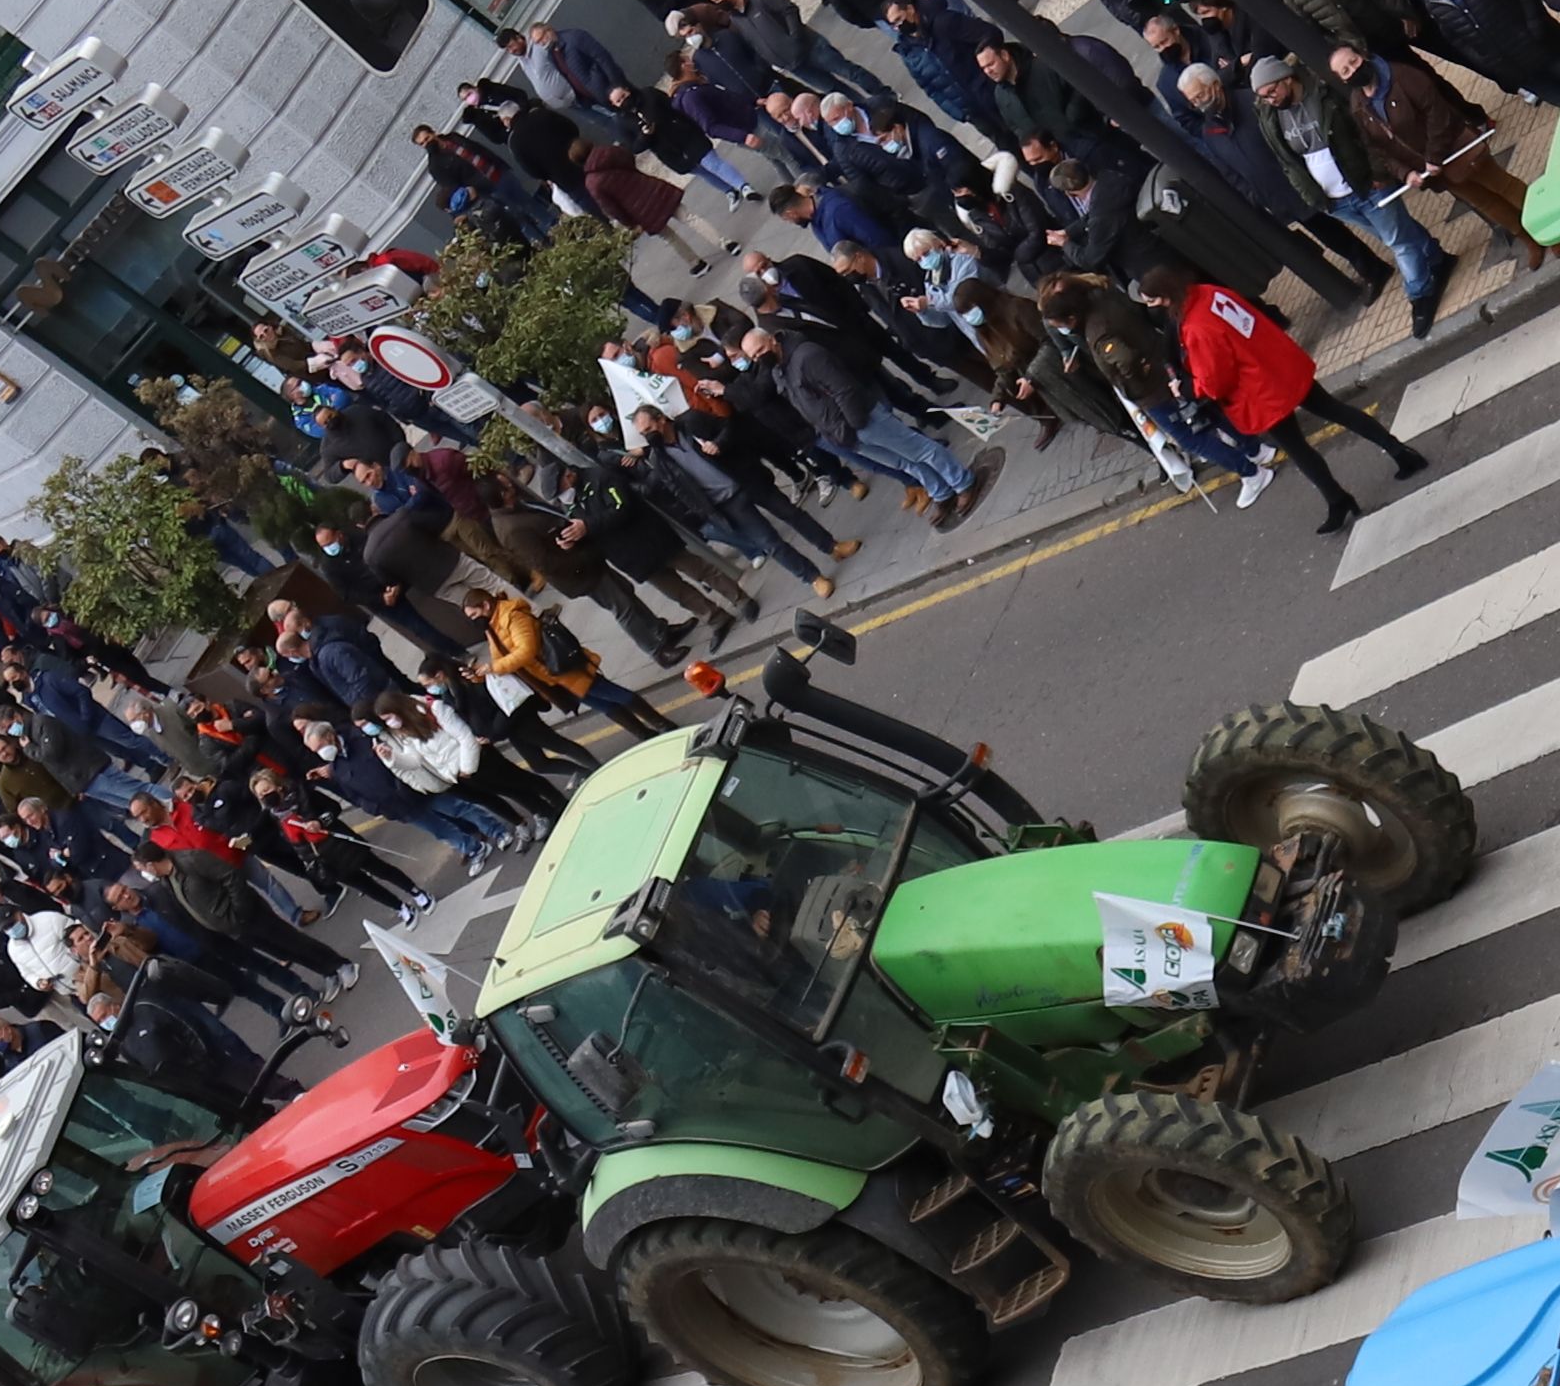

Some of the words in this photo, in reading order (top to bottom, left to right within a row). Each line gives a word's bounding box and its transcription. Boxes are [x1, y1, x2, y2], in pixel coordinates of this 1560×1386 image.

[50, 65, 103, 103] SALAMANCA
[108, 105, 157, 139] TORDESILLAS
[123, 117, 168, 150] VALLADOLID
[163, 150, 217, 186] FUENTESAUCO
[181, 160, 229, 192] FERMOSELLE
[239, 201, 286, 231] Hospitales
[250, 261, 290, 292] ALCAÑICES
[260, 268, 311, 300] BRAGANÇA
[321, 313, 358, 334] ORENSE
[1192, 988, 1210, 1008] UPA
[225, 1205, 269, 1233] MASSEY
[268, 1175, 326, 1211] FERGUSON
[336, 1159, 359, 1174] S
[356, 1141, 391, 1163] 7715
